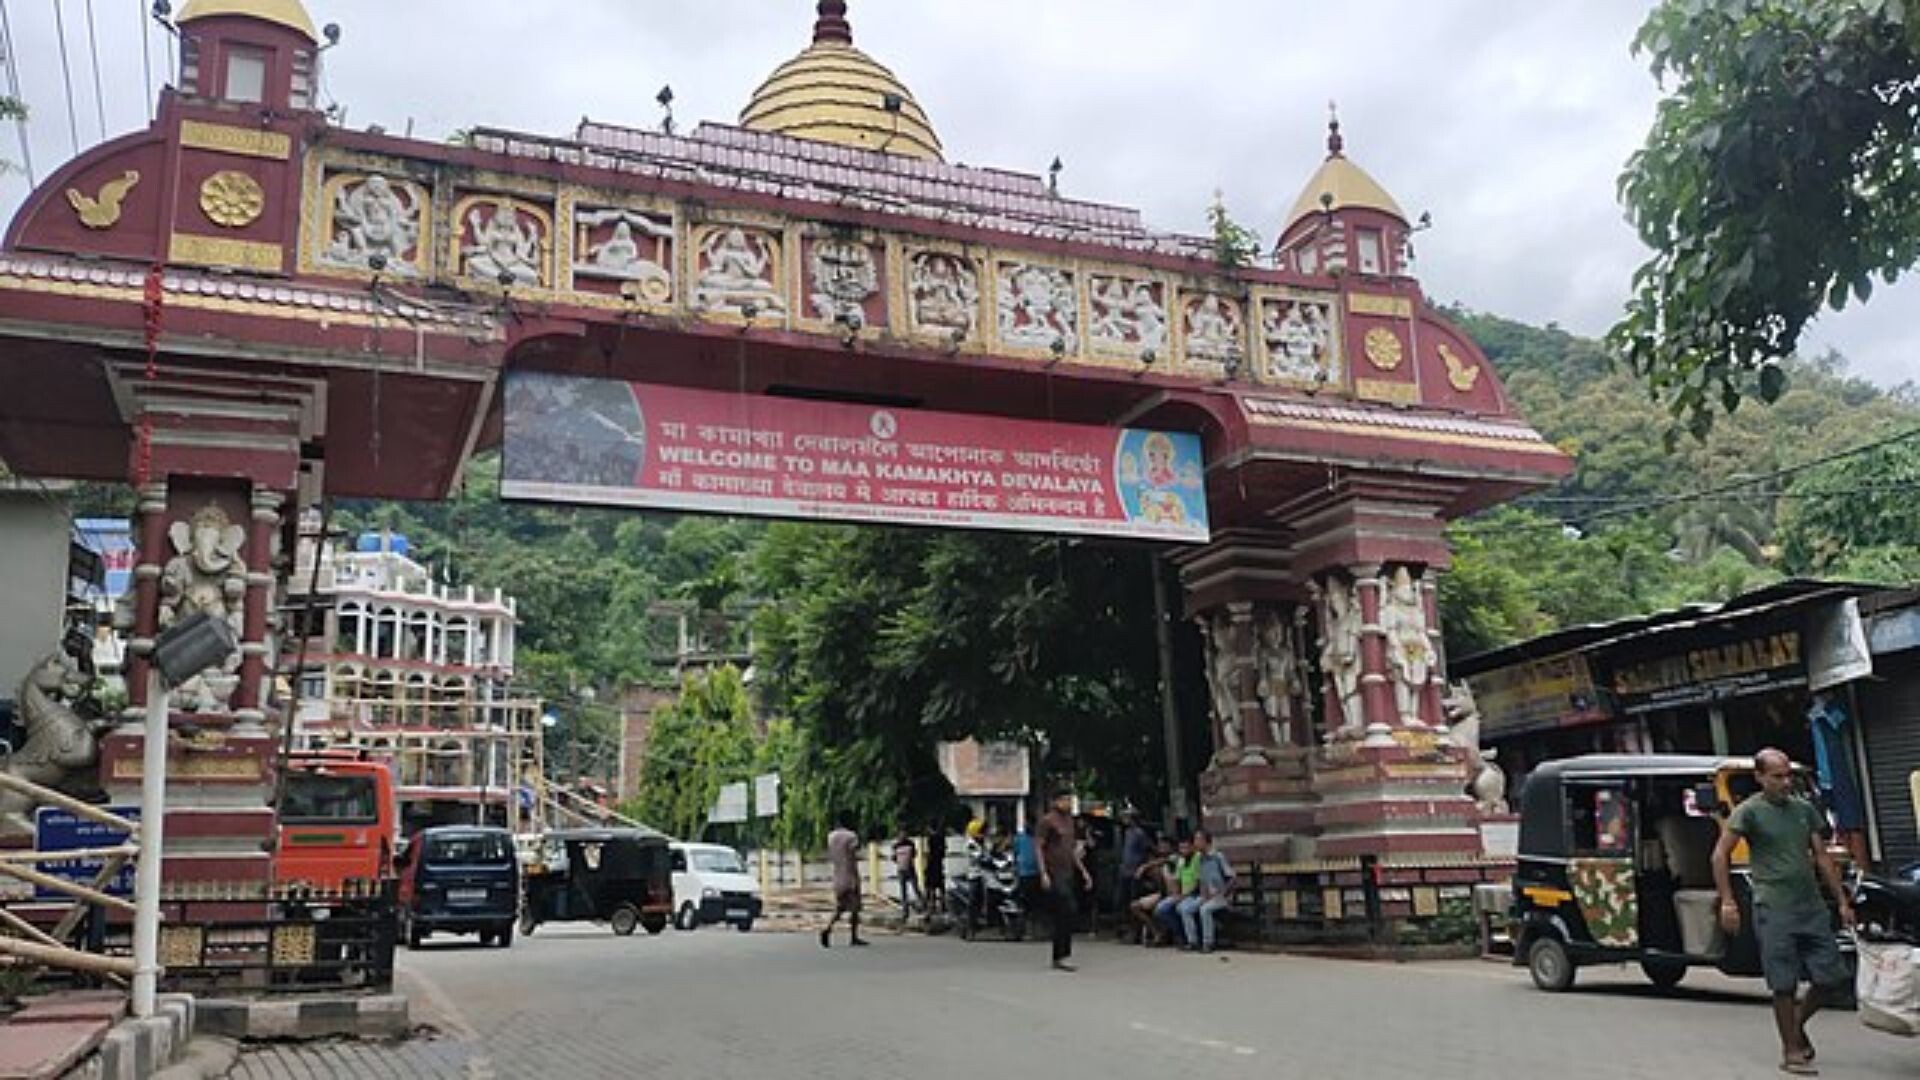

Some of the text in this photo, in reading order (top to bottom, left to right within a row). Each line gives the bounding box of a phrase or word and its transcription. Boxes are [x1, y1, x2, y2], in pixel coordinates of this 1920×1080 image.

[658, 446, 1105, 495] WELCOME TO MAA KAMAKHYA DEVALAYA
